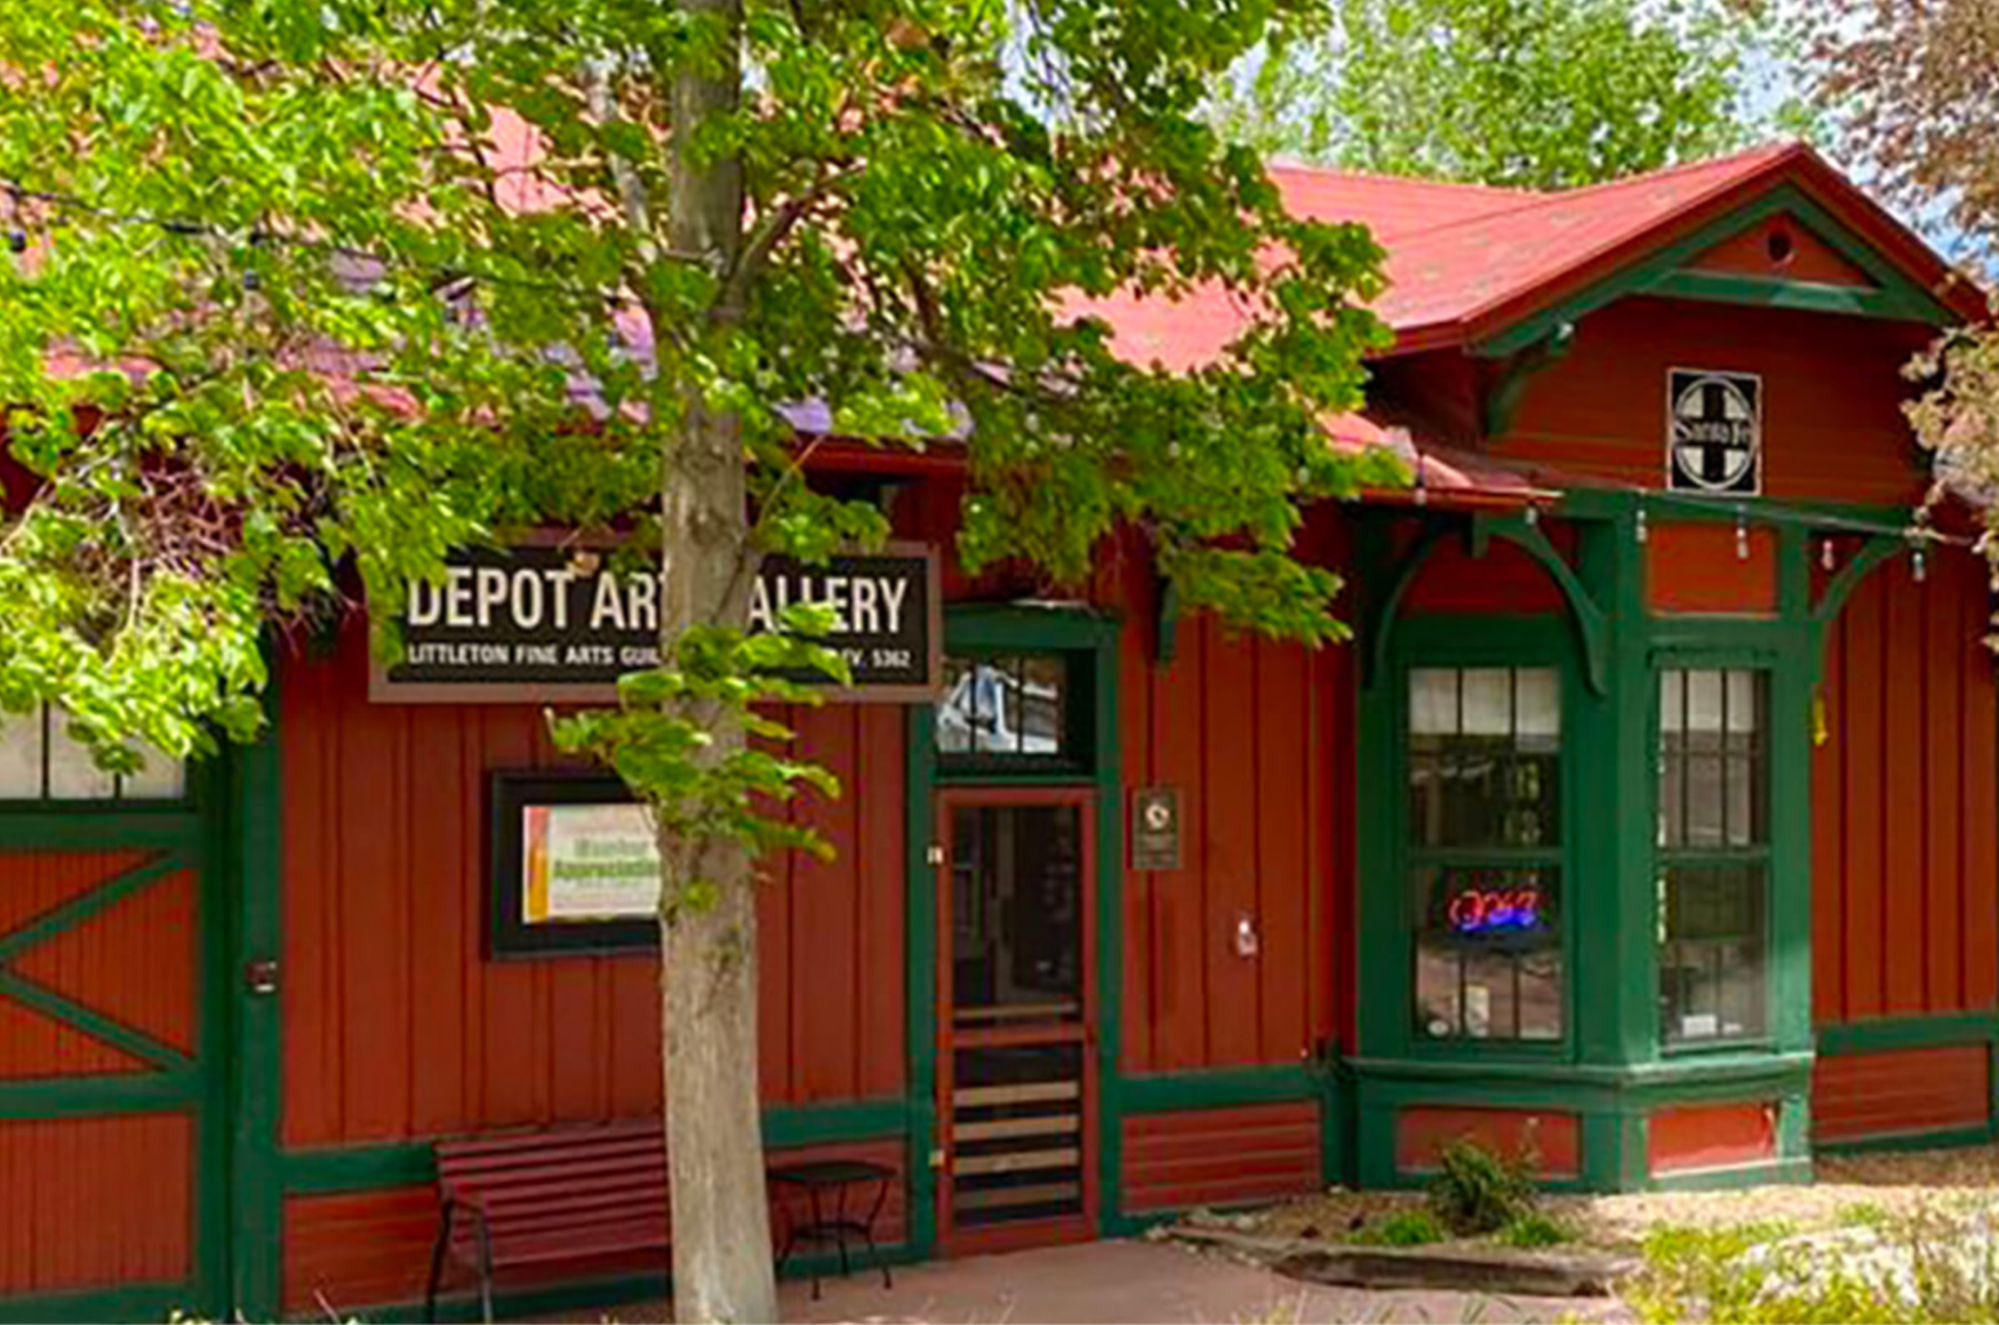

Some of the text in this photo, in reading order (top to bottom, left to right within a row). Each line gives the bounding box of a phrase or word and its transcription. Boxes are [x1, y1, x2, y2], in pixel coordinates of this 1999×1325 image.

[408, 567, 908, 634] DEPOT AR ALERY
[408, 644, 508, 664] LITTLETON
[514, 646, 559, 665] FINE
[565, 647, 614, 666] ARTS
[619, 645, 662, 668] GUIL
[872, 649, 912, 670] 5362
